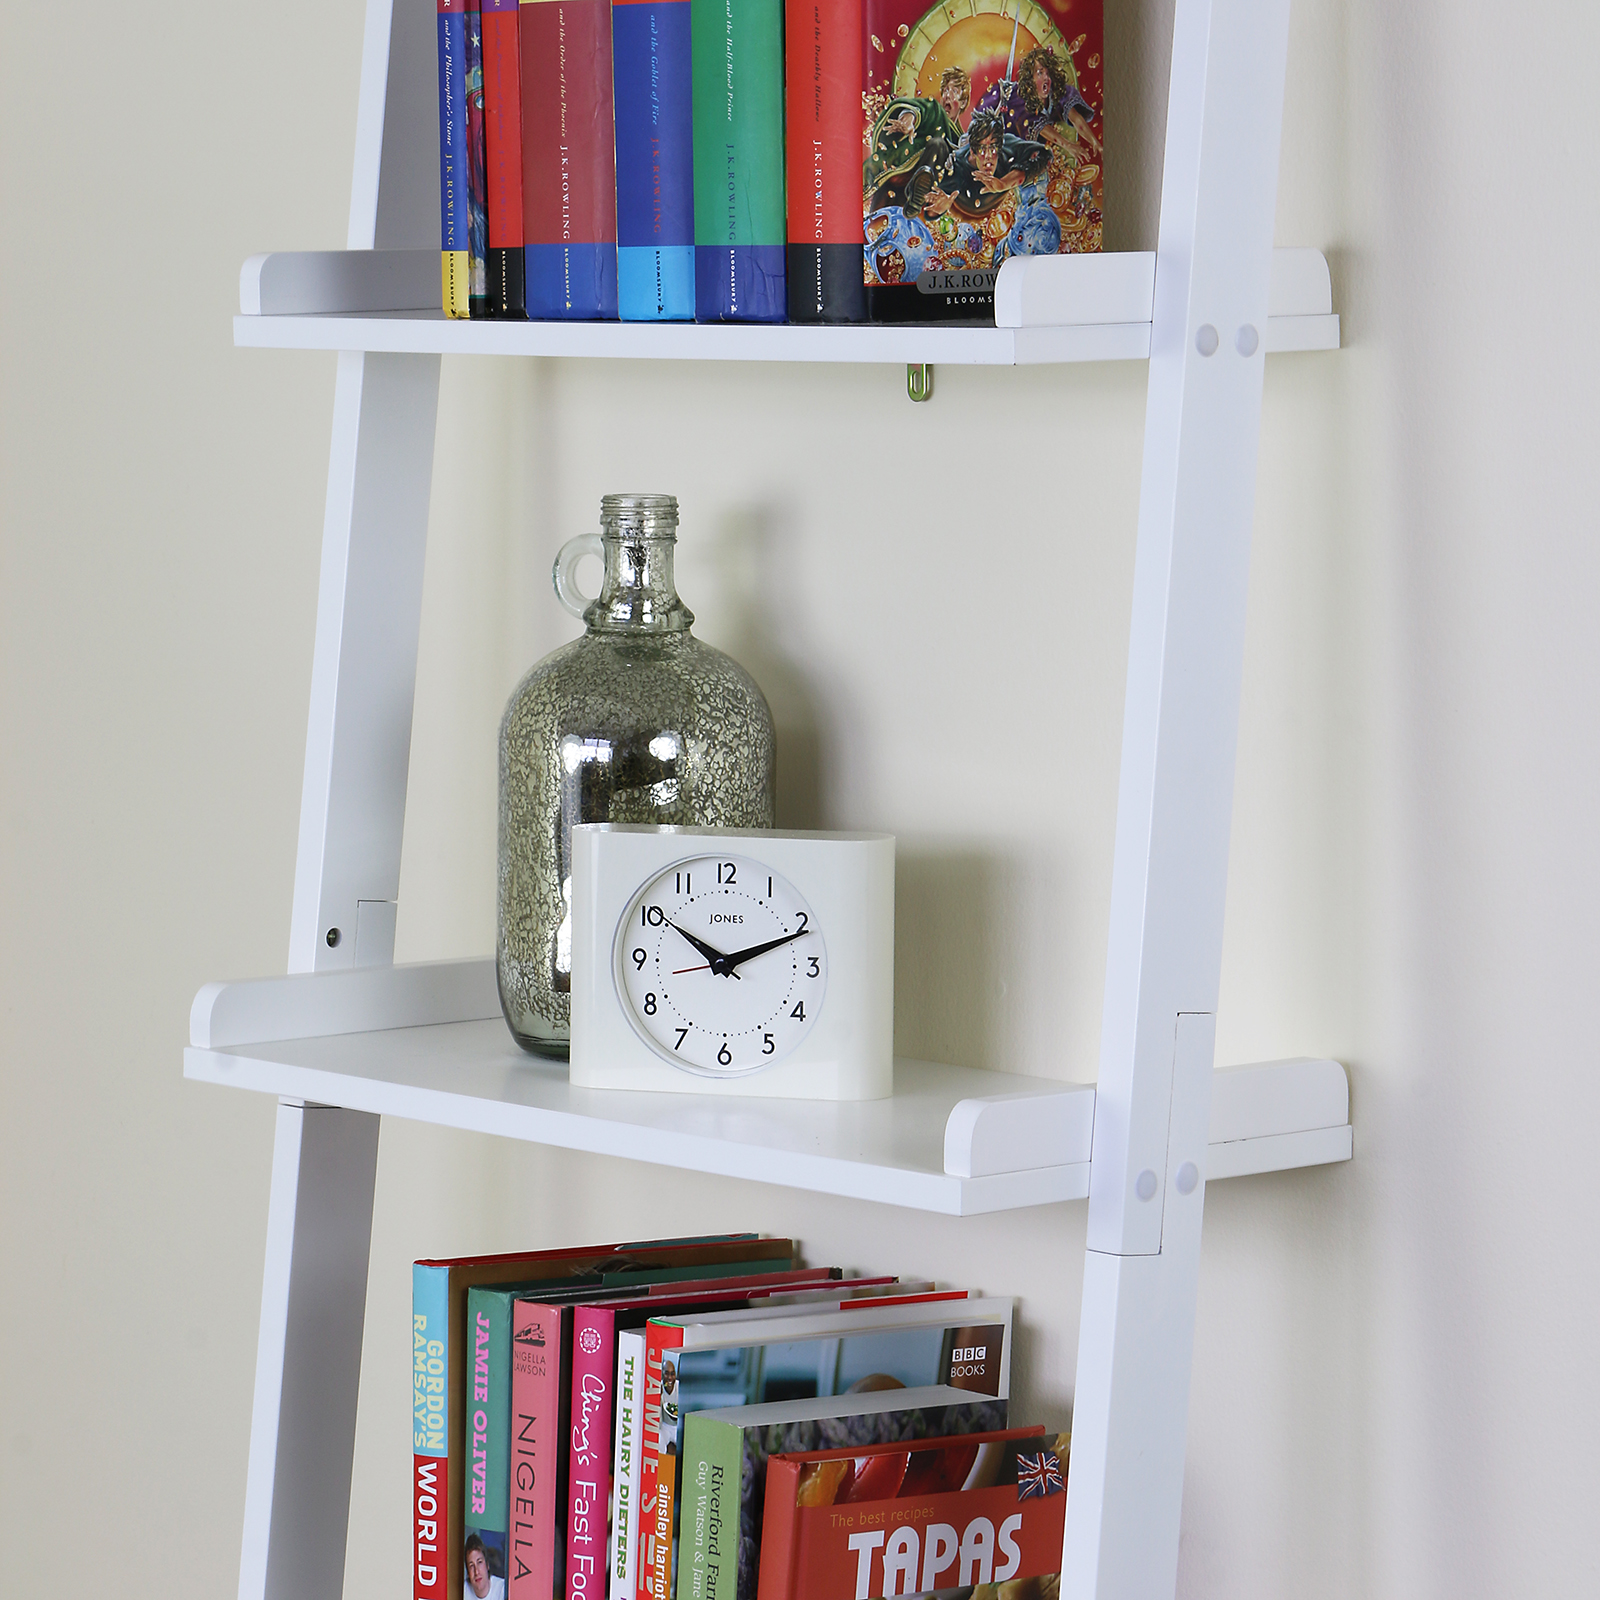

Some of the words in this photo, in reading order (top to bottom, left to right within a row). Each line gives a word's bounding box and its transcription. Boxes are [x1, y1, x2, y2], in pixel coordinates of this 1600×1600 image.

[560, 73, 566, 83] of
[651, 56, 659, 88] Goblet
[445, 55, 453, 116] Philosopher's
[650, 91, 659, 102] of
[928, 273, 996, 289] J.K.ROW
[946, 296, 993, 305] BLOOMS
[676, 872, 691, 894] 11
[717, 863, 737, 884] 12
[768, 876, 772, 898] 1
[642, 905, 664, 927] 10
[709, 914, 744, 925] JONES
[795, 912, 809, 933] 2
[632, 948, 647, 971] 9
[806, 957, 820, 978] 3
[643, 992, 657, 1016] 8
[790, 1001, 806, 1022] 4
[675, 1028, 688, 1050] 7
[761, 1033, 775, 1054] 5
[717, 1042, 732, 1066] 6
[474, 1312, 490, 1403] JAMIE
[514, 1351, 546, 1365] NIGELLA
[953, 1347, 986, 1361] BBC
[414, 1314, 427, 1448] RAMSAY'S
[623, 1356, 635, 1401] THE
[950, 1364, 985, 1378] BOOKS
[426, 1340, 445, 1450] GORDON
[572, 1373, 606, 1466] Ching's
[621, 1407, 632, 1478] HAIRY
[472, 1410, 488, 1515] OLIVER
[695, 1461, 709, 1490] Guy
[514, 1413, 538, 1580] NIGELLA
[573, 1480, 597, 1545] Fast
[655, 1484, 671, 1541] ainsley
[695, 1495, 707, 1546] Watson
[708, 1464, 724, 1557] Riverford
[830, 1514, 854, 1527] The
[860, 1512, 885, 1525] best
[890, 1506, 935, 1522] recipes
[417, 1462, 438, 1586] WORLD
[616, 1484, 630, 1580] DIETERS
[694, 1551, 704, 1563] &
[848, 1513, 1023, 1600] TAPAS
[571, 1554, 594, 1600] Foo
[654, 1545, 669, 1600] harriot
[692, 1566, 703, 1598] Jane
[706, 1563, 719, 1600] Far
